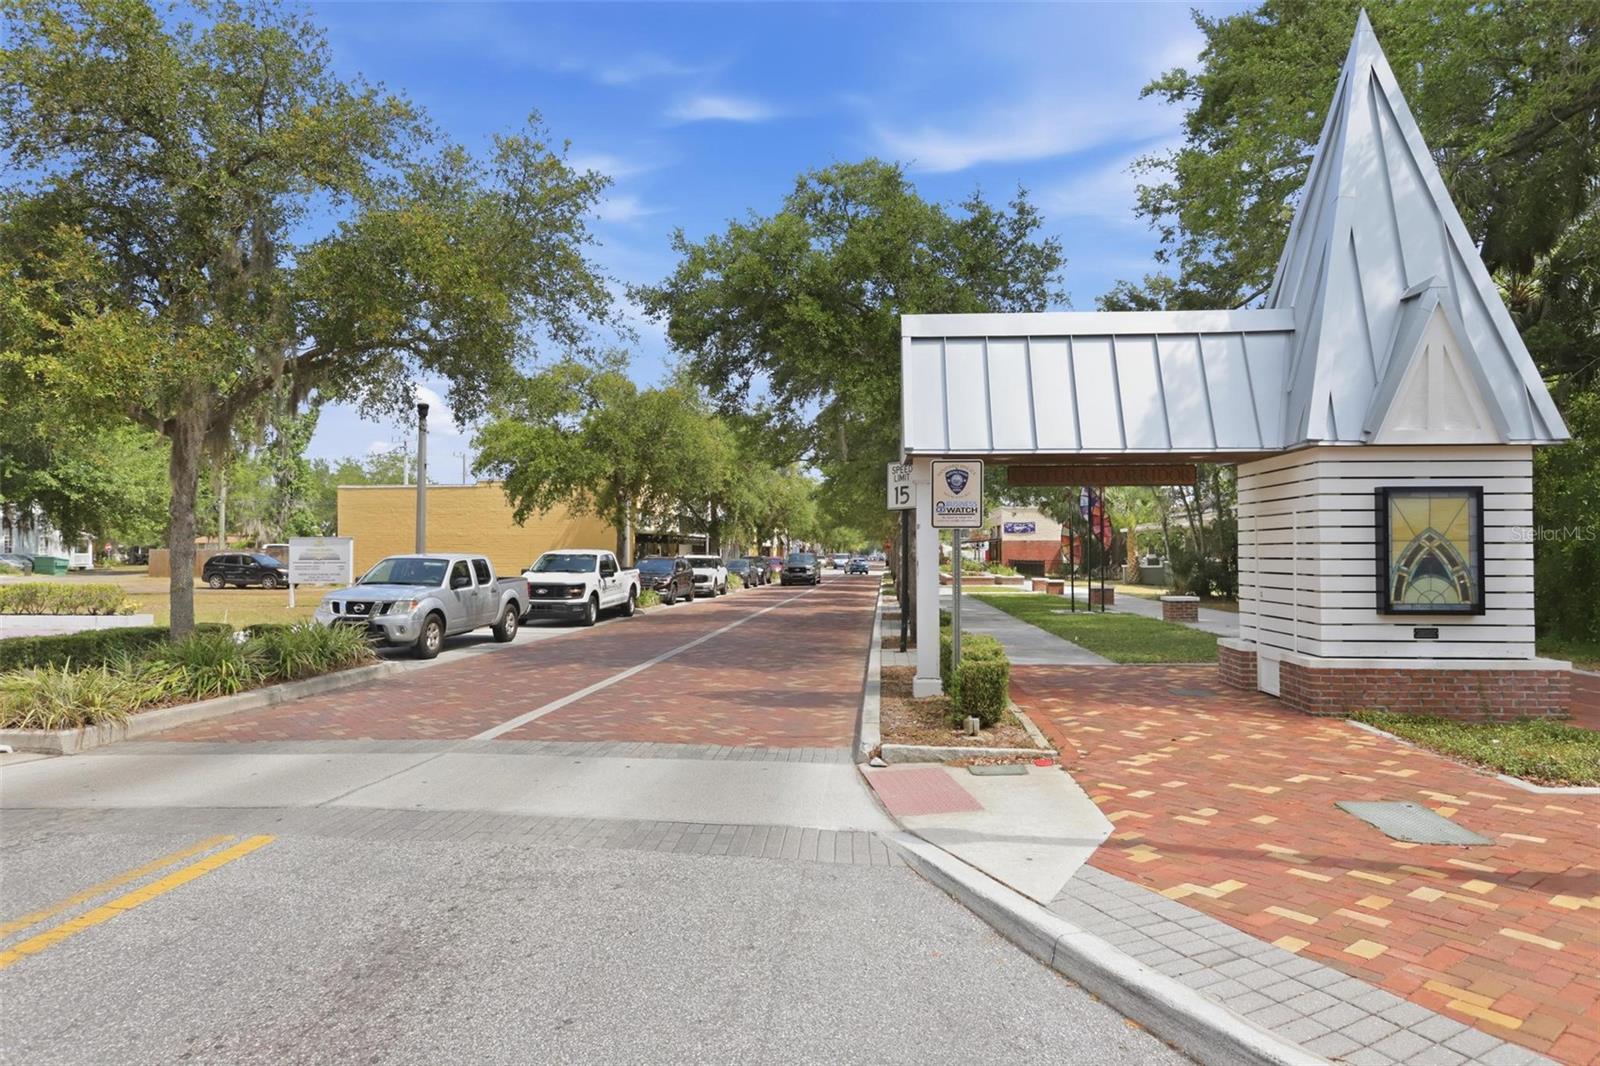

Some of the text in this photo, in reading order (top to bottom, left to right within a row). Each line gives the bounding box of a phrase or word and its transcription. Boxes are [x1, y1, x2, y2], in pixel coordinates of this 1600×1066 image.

[892, 465, 913, 474] SPEED
[1104, 468, 1192, 482] CORRIDOR
[894, 474, 910, 482] LIMIT
[894, 486, 910, 504] 15
